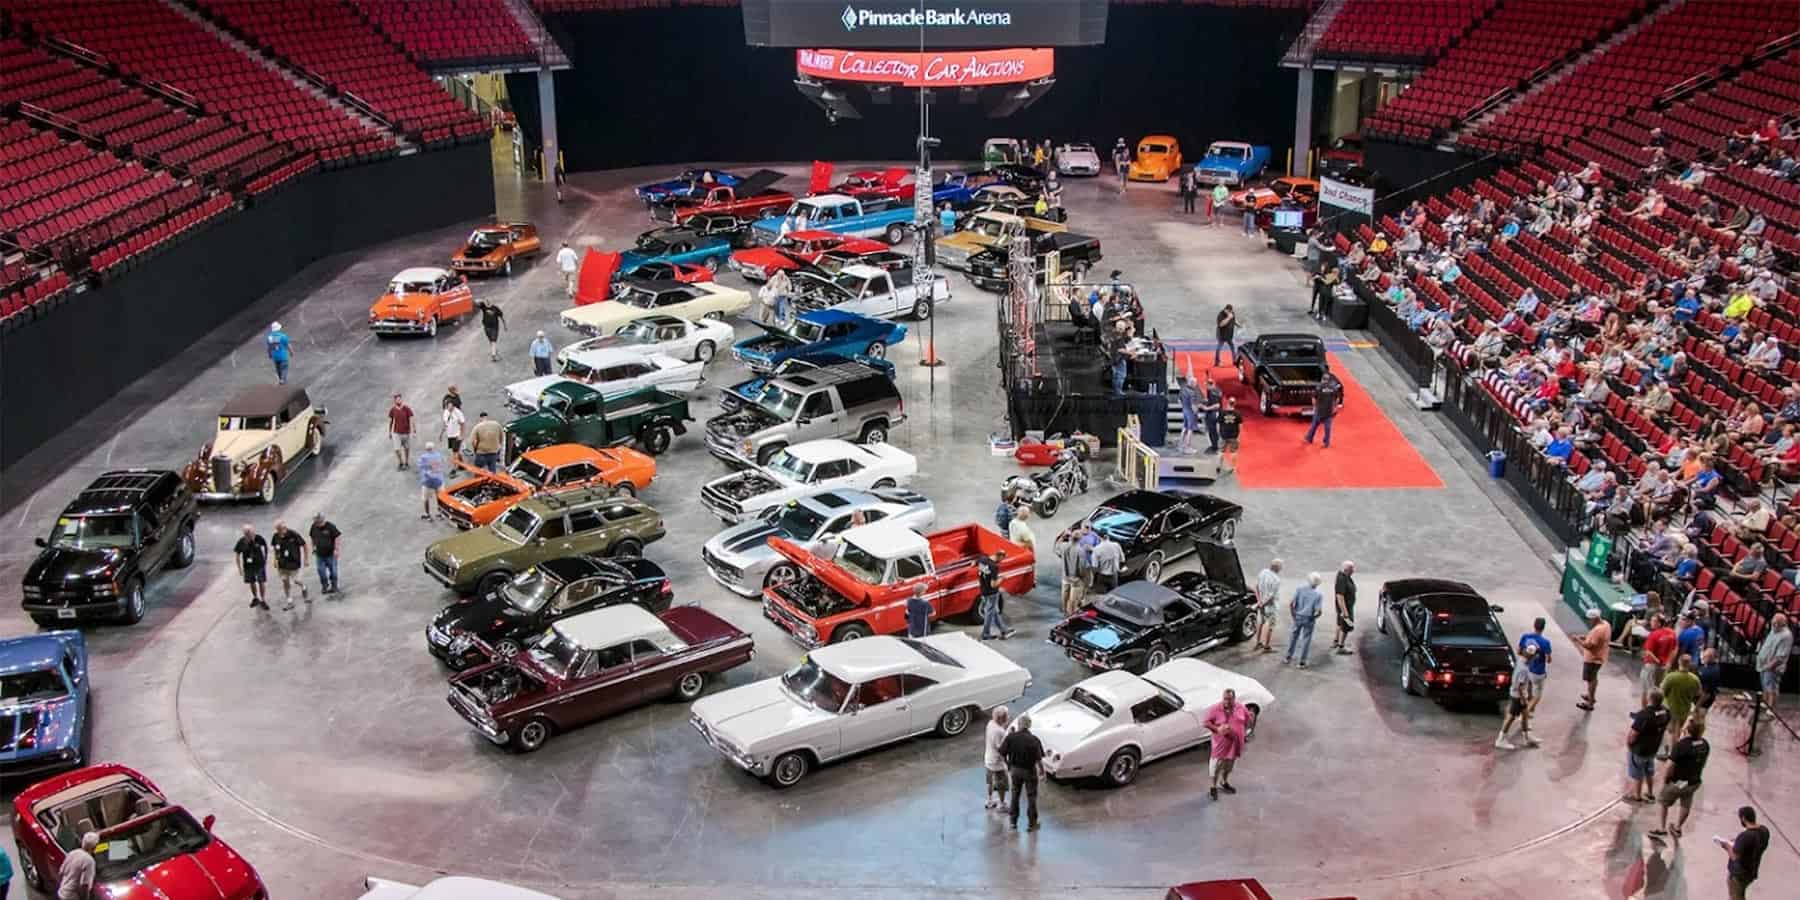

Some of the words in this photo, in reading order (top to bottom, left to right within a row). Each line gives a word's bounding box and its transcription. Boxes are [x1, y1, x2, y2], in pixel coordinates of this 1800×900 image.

[859, 8, 925, 26] Pinnacle
[925, 8, 966, 26] Bank
[966, 9, 1011, 26] Arena
[924, 57, 960, 80] CAR
